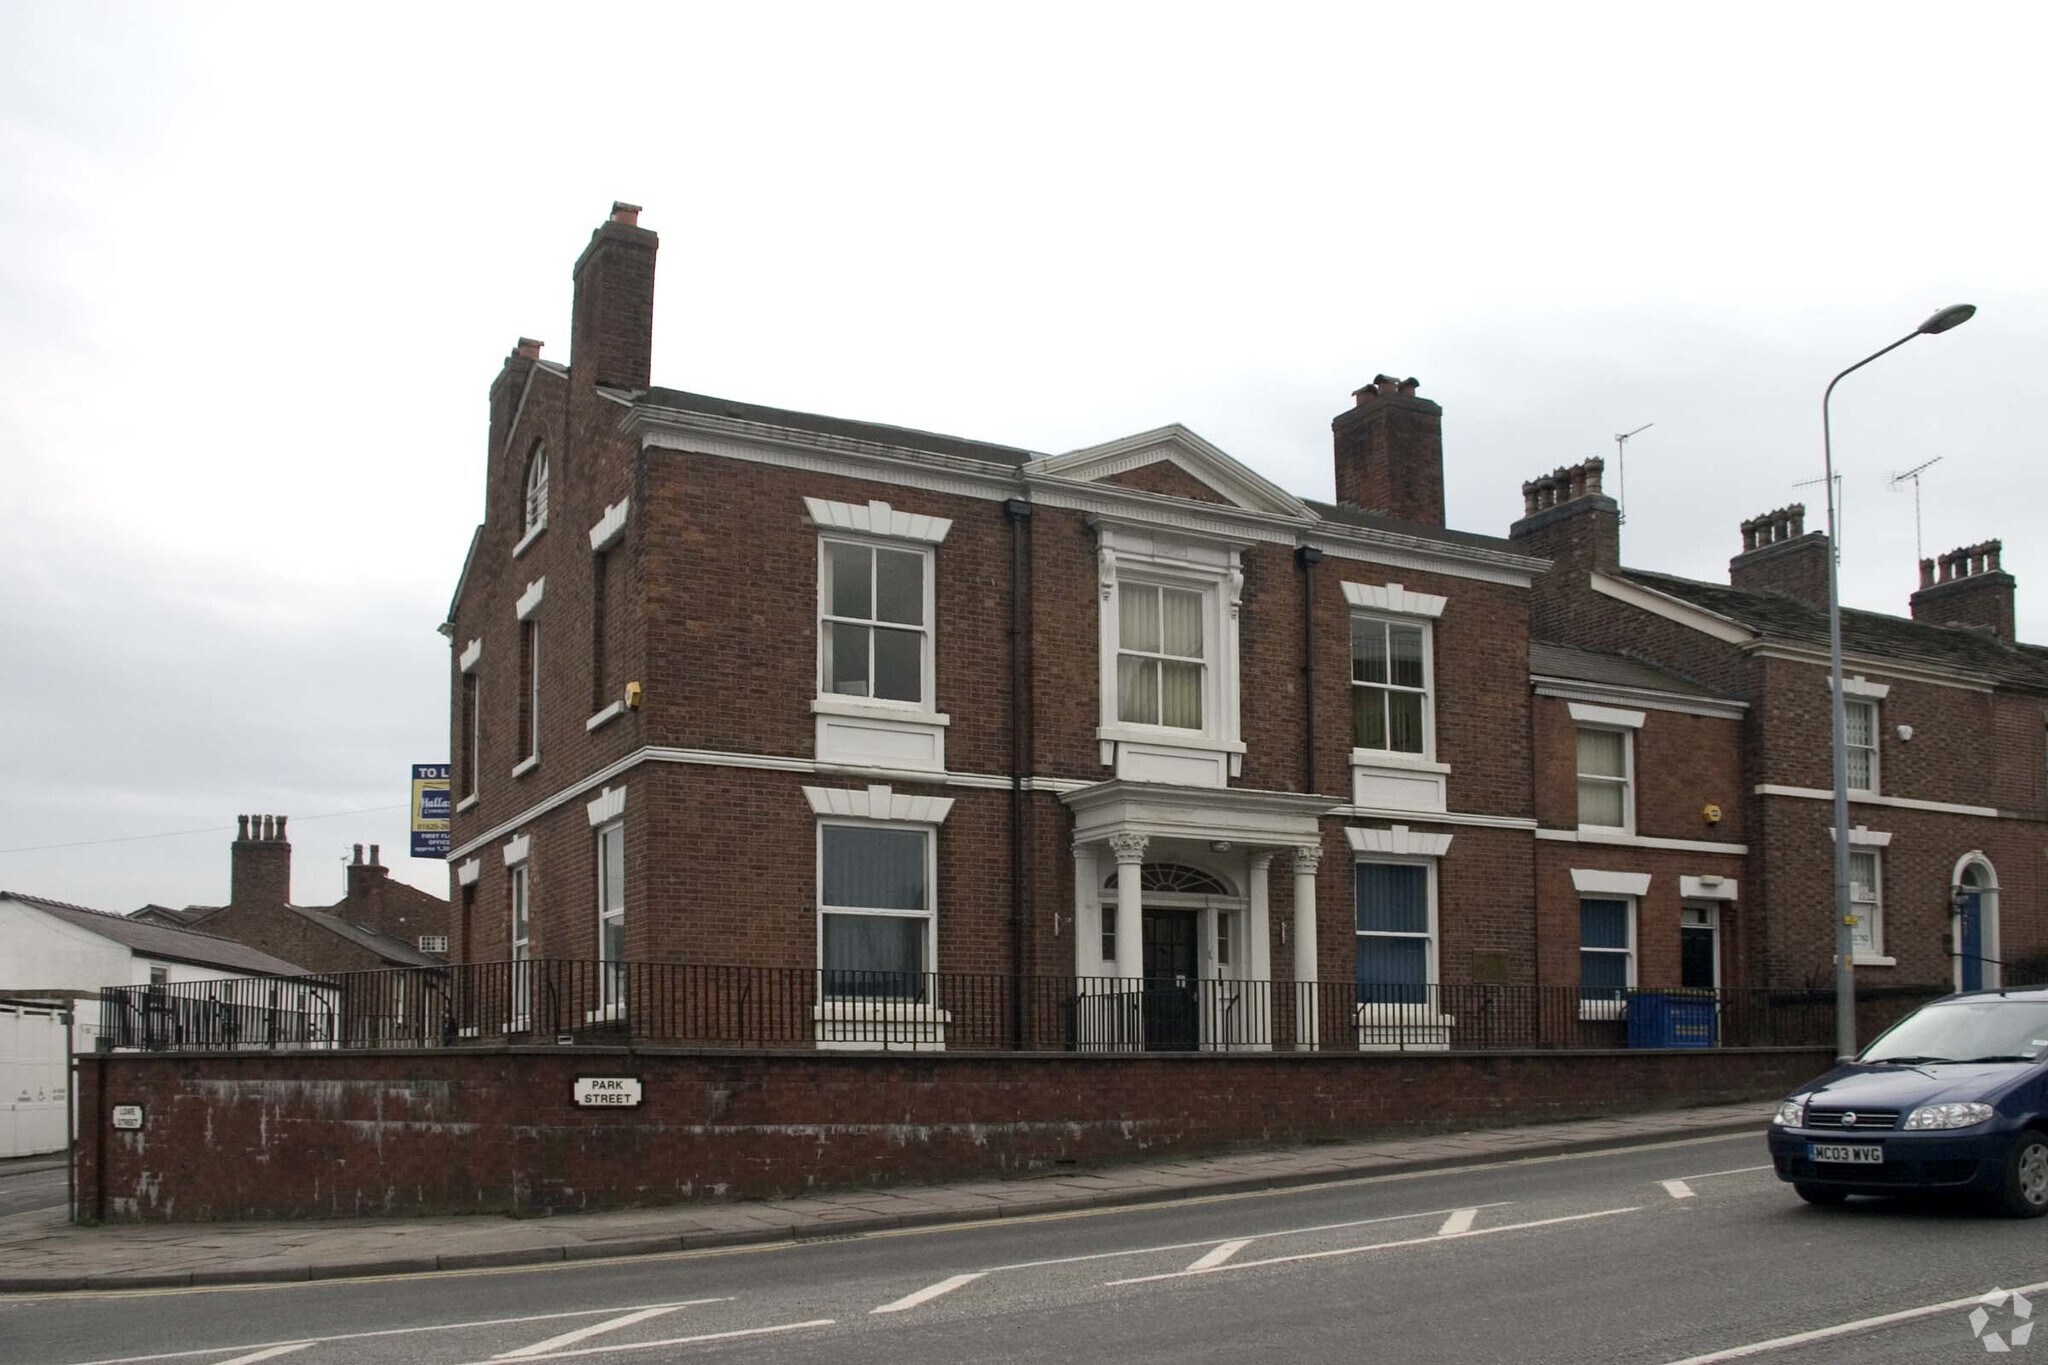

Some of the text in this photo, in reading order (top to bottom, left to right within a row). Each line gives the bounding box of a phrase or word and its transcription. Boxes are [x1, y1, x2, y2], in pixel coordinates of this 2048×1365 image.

[418, 767, 450, 778] TO L
[592, 1080, 623, 1090] PARK
[585, 1093, 632, 1103] STREET
